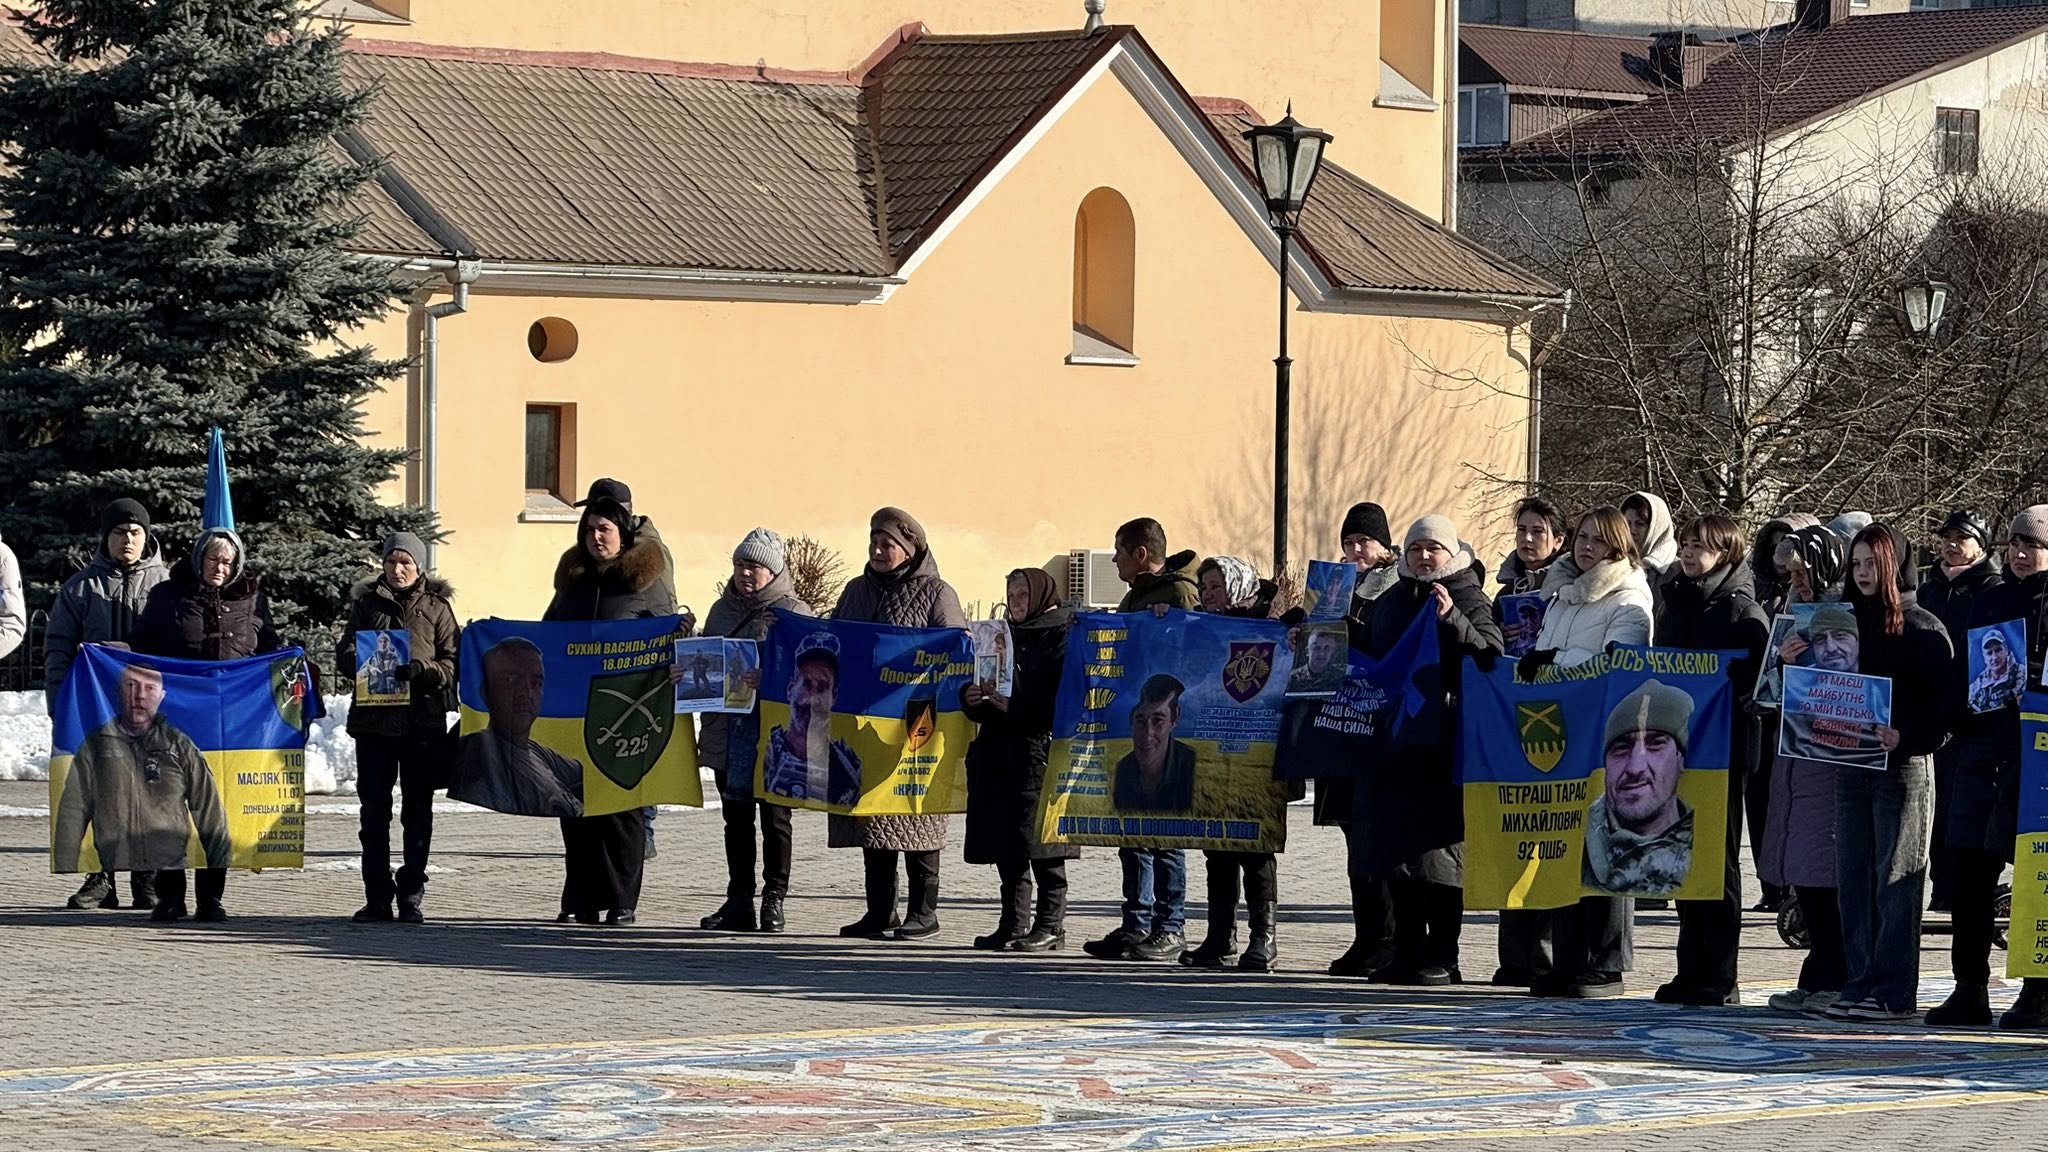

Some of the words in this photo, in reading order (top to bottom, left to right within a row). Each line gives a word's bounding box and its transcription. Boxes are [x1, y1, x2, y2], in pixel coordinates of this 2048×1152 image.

[567, 641, 601, 656] СУХИЙ
[603, 640, 646, 654] ВАСИЛЬ
[602, 652, 658, 671] 18.08.1989
[1563, 648, 1644, 681] НАДІЄОСЬ
[1646, 651, 1719, 675] ЧЕКАЄМО
[1830, 674, 1864, 689] МАЄШ
[1808, 687, 1866, 704] МАЙБУТНЄ
[1321, 703, 1344, 718] НАШ
[1813, 703, 1833, 714] МІЙ
[1835, 705, 1876, 720] БАТЬКО
[1313, 716, 1342, 732] НАША
[1343, 721, 1375, 736] СИЛА!
[615, 733, 649, 758] 225
[237, 772, 280, 785] МАСЛЯК
[277, 787, 304, 799] 11.07.
[1498, 785, 1552, 805] ПЕТРАШ
[1555, 781, 1587, 803] ТАРАС
[242, 804, 279, 815] ДОНЕЦЬКА
[1206, 820, 1223, 839] ЗА
[1501, 810, 1582, 832] МИХАЙЛОВИЧ
[1517, 841, 1536, 860] 92
